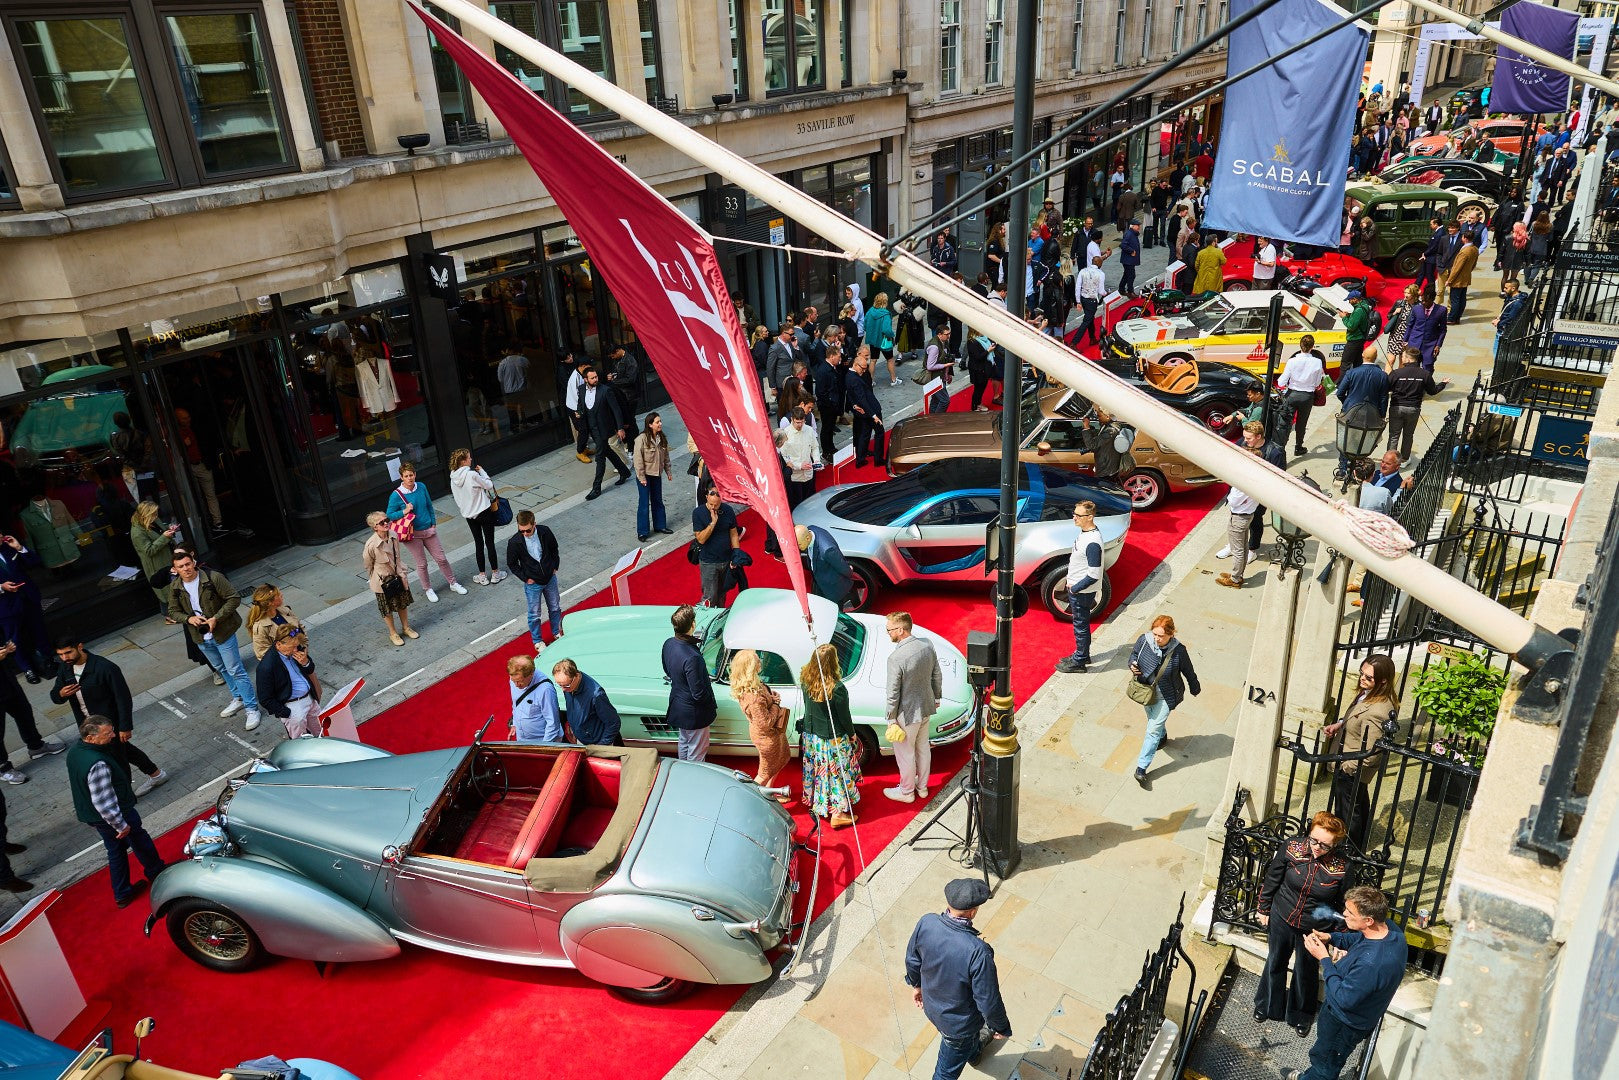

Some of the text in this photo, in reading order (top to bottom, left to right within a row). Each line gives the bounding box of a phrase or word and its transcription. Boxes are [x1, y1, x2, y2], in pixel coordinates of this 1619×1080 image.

[796, 113, 856, 135] 33 SAVILE ROW
[1232, 159, 1331, 186] SCABAL
[1253, 181, 1276, 191] PASSION
[1277, 186, 1288, 194] FOR
[1289, 187, 1312, 196] CLOTH
[724, 196, 739, 211] 33
[1562, 250, 1593, 259] RICHARD
[1558, 335, 1589, 344] HIDALGO
